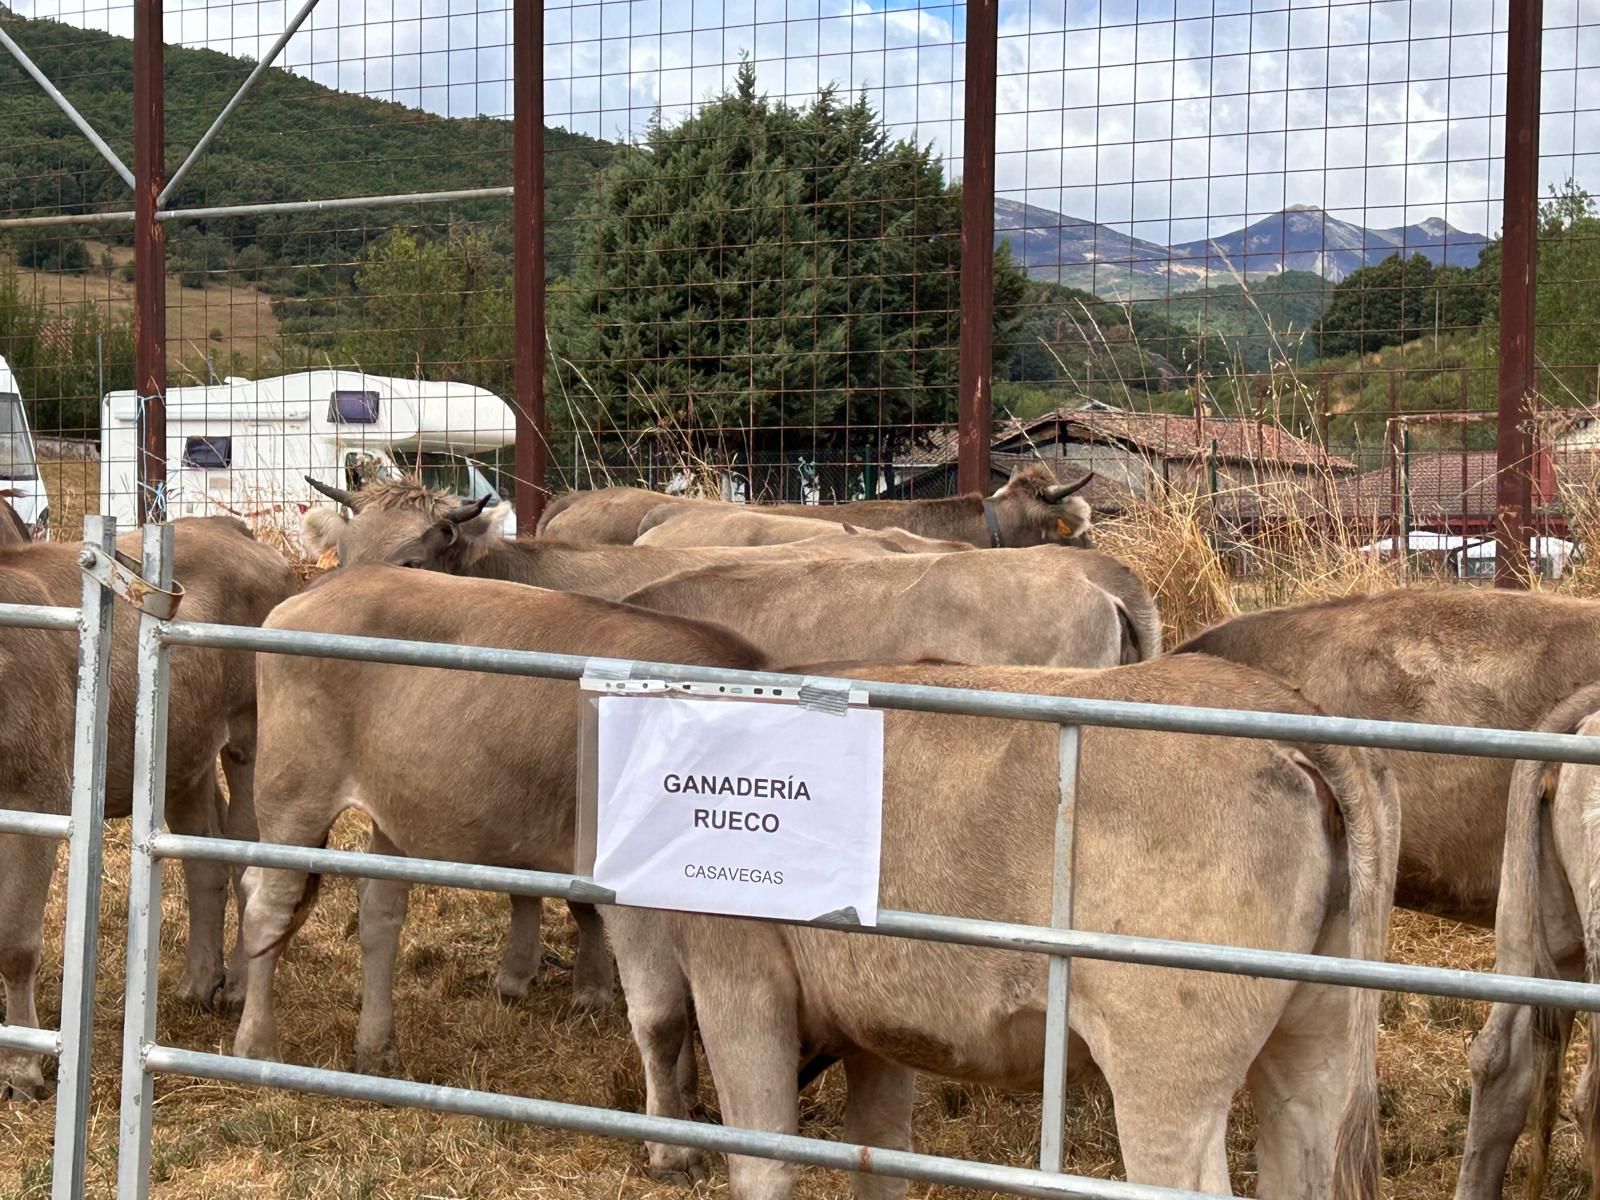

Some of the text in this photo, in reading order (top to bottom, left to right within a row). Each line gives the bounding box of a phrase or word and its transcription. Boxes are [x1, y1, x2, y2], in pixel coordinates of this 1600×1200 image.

[663, 774, 811, 801] GANADERÍA
[694, 808, 780, 833] RUECO
[684, 864, 784, 885] CASAVEGAS
